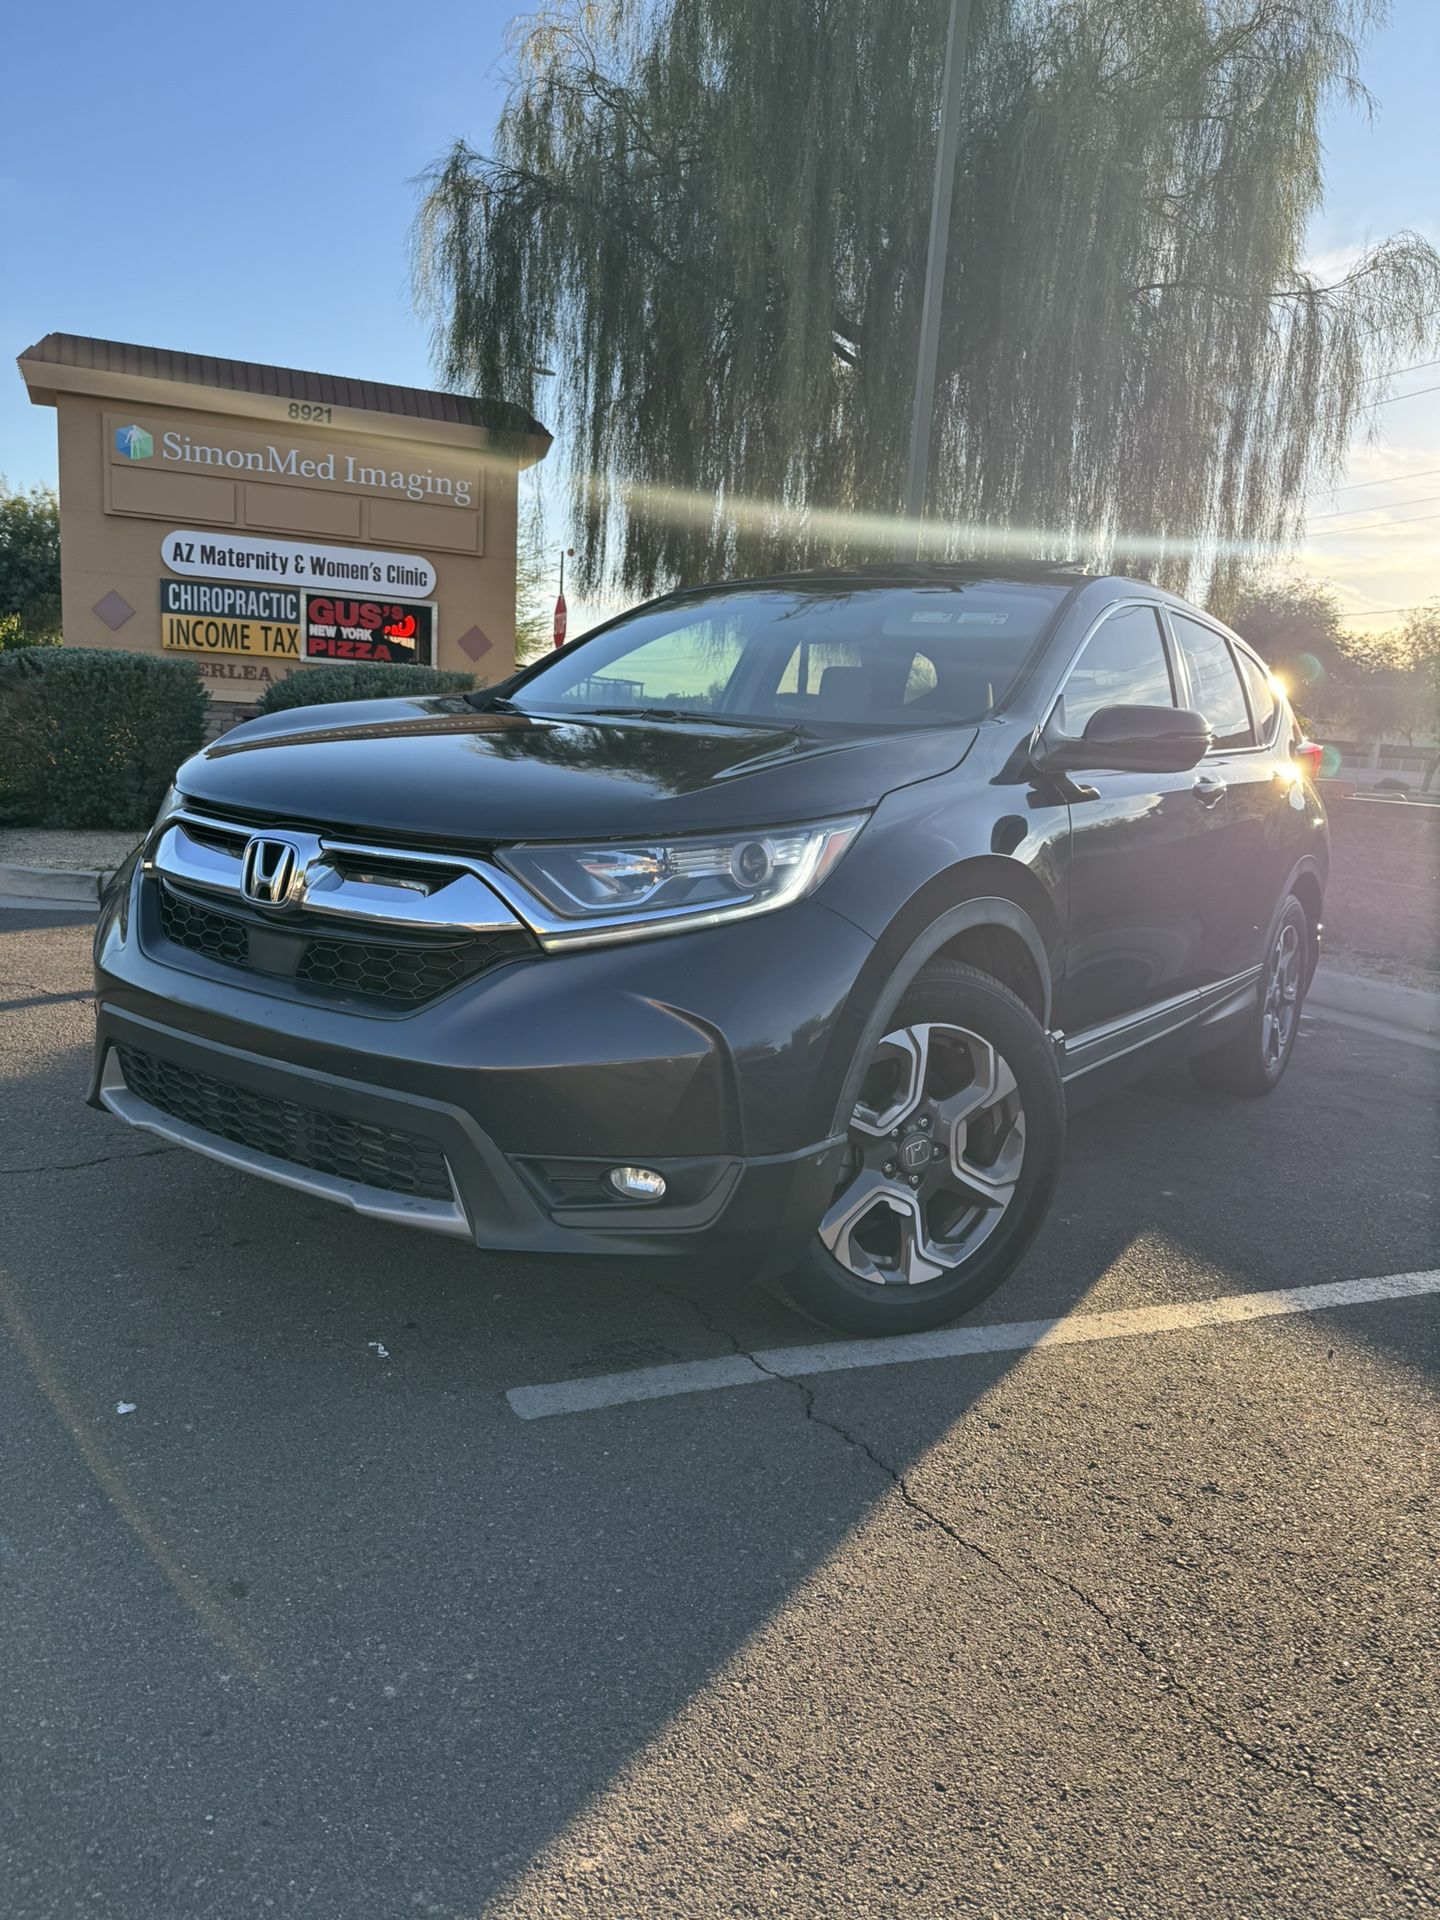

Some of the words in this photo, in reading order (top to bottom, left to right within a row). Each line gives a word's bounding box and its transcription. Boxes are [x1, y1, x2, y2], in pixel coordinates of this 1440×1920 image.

[288, 402, 332, 424] 8921
[163, 432, 336, 481] SimonMed
[344, 456, 472, 506] Imaging
[173, 542, 195, 563] AZ
[200, 544, 289, 575] Maternity
[294, 554, 305, 574] &
[310, 556, 381, 582] Women's
[387, 565, 428, 587] Clinic
[168, 583, 297, 620] CHIROPRACTIC
[169, 618, 251, 650] INCOME
[260, 625, 299, 654] TAX
[309, 623, 337, 637] NEW
[340, 627, 373, 642] YORK
[308, 638, 393, 661] PIZZA
[198, 661, 275, 682] ERLEA
